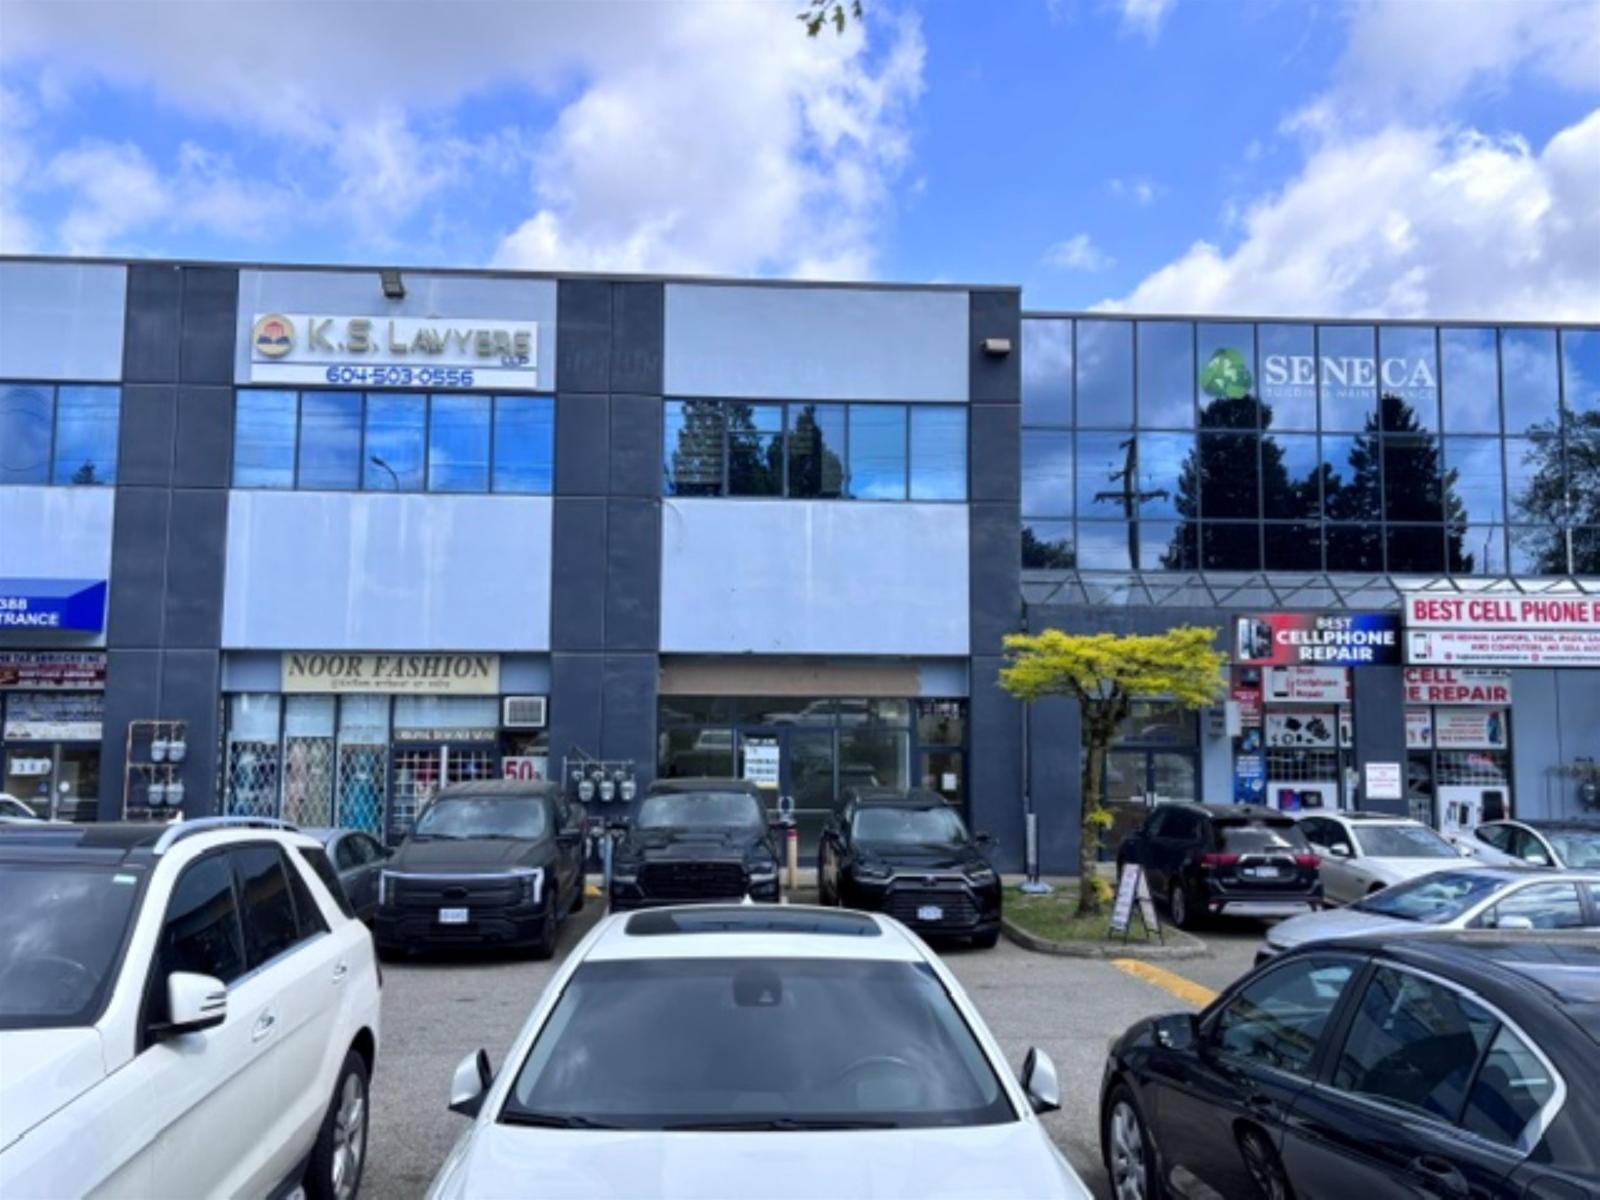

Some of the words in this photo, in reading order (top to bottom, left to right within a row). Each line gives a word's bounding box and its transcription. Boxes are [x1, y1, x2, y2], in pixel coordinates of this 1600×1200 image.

[326, 366, 474, 386] 604-503-0556
[1265, 355, 1436, 388] SENECA
[1414, 600, 1464, 621] BEST
[1468, 601, 1517, 622] CELL
[1521, 601, 1589, 623] PHONE
[1316, 617, 1353, 630] BEST
[1276, 630, 1396, 646] CELLPHONE
[1299, 646, 1374, 662] REPAIR
[289, 655, 362, 677] NOOR
[372, 655, 491, 678] FASHION
[1406, 668, 1457, 683] CELL
[1429, 686, 1507, 701] REPAIR
